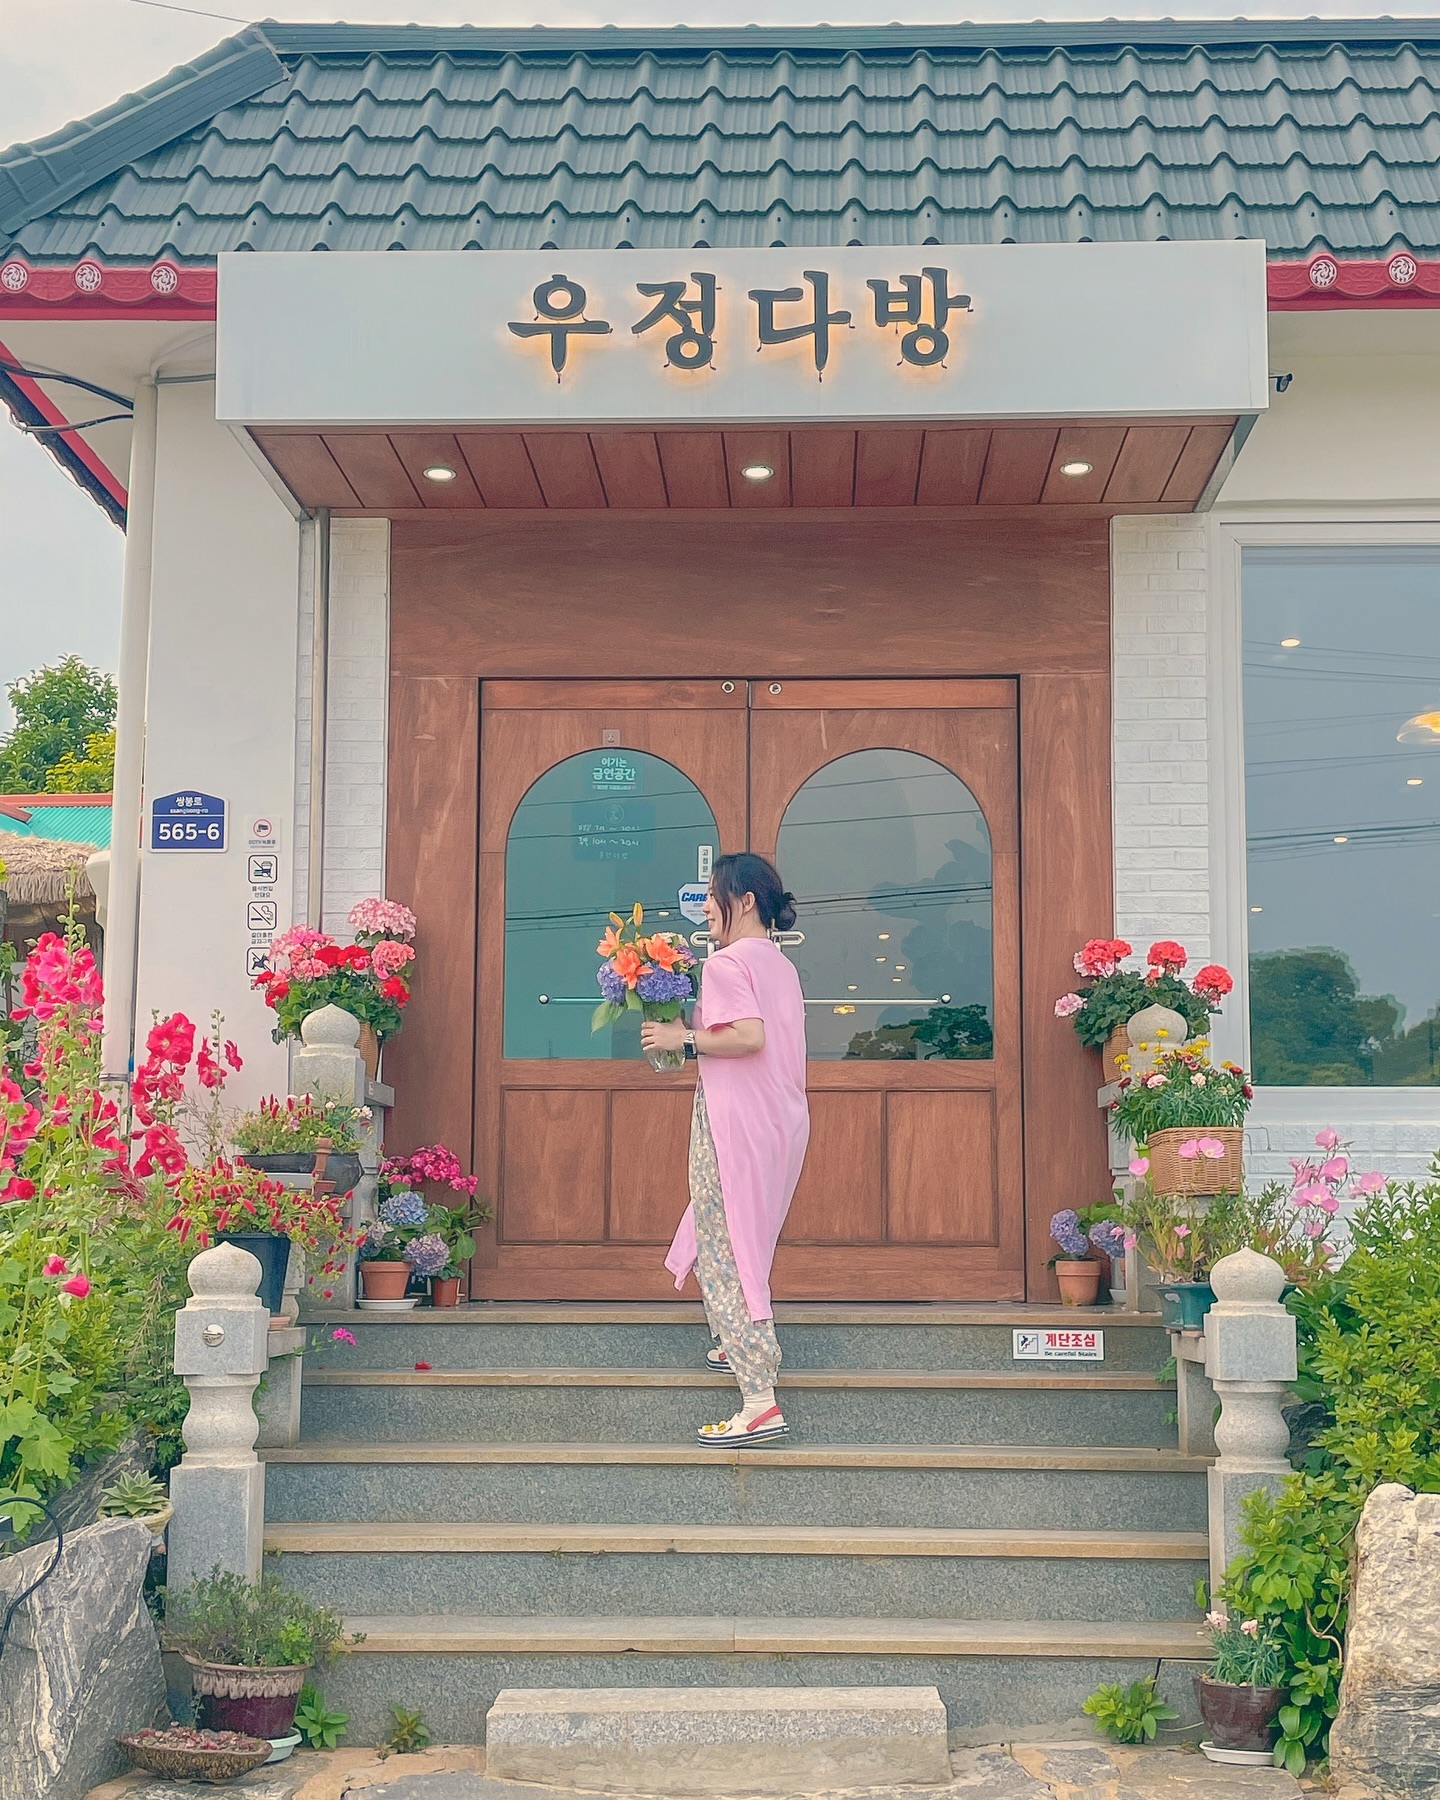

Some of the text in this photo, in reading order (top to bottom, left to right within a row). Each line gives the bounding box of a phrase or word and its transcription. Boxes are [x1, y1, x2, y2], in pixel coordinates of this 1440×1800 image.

[507, 266, 972, 374] 우정다방
[592, 767, 637, 781] 금연공간
[175, 796, 203, 808] 쌍봉로
[158, 822, 221, 841] 565-6
[1045, 1333, 1095, 1347] 계단조심
